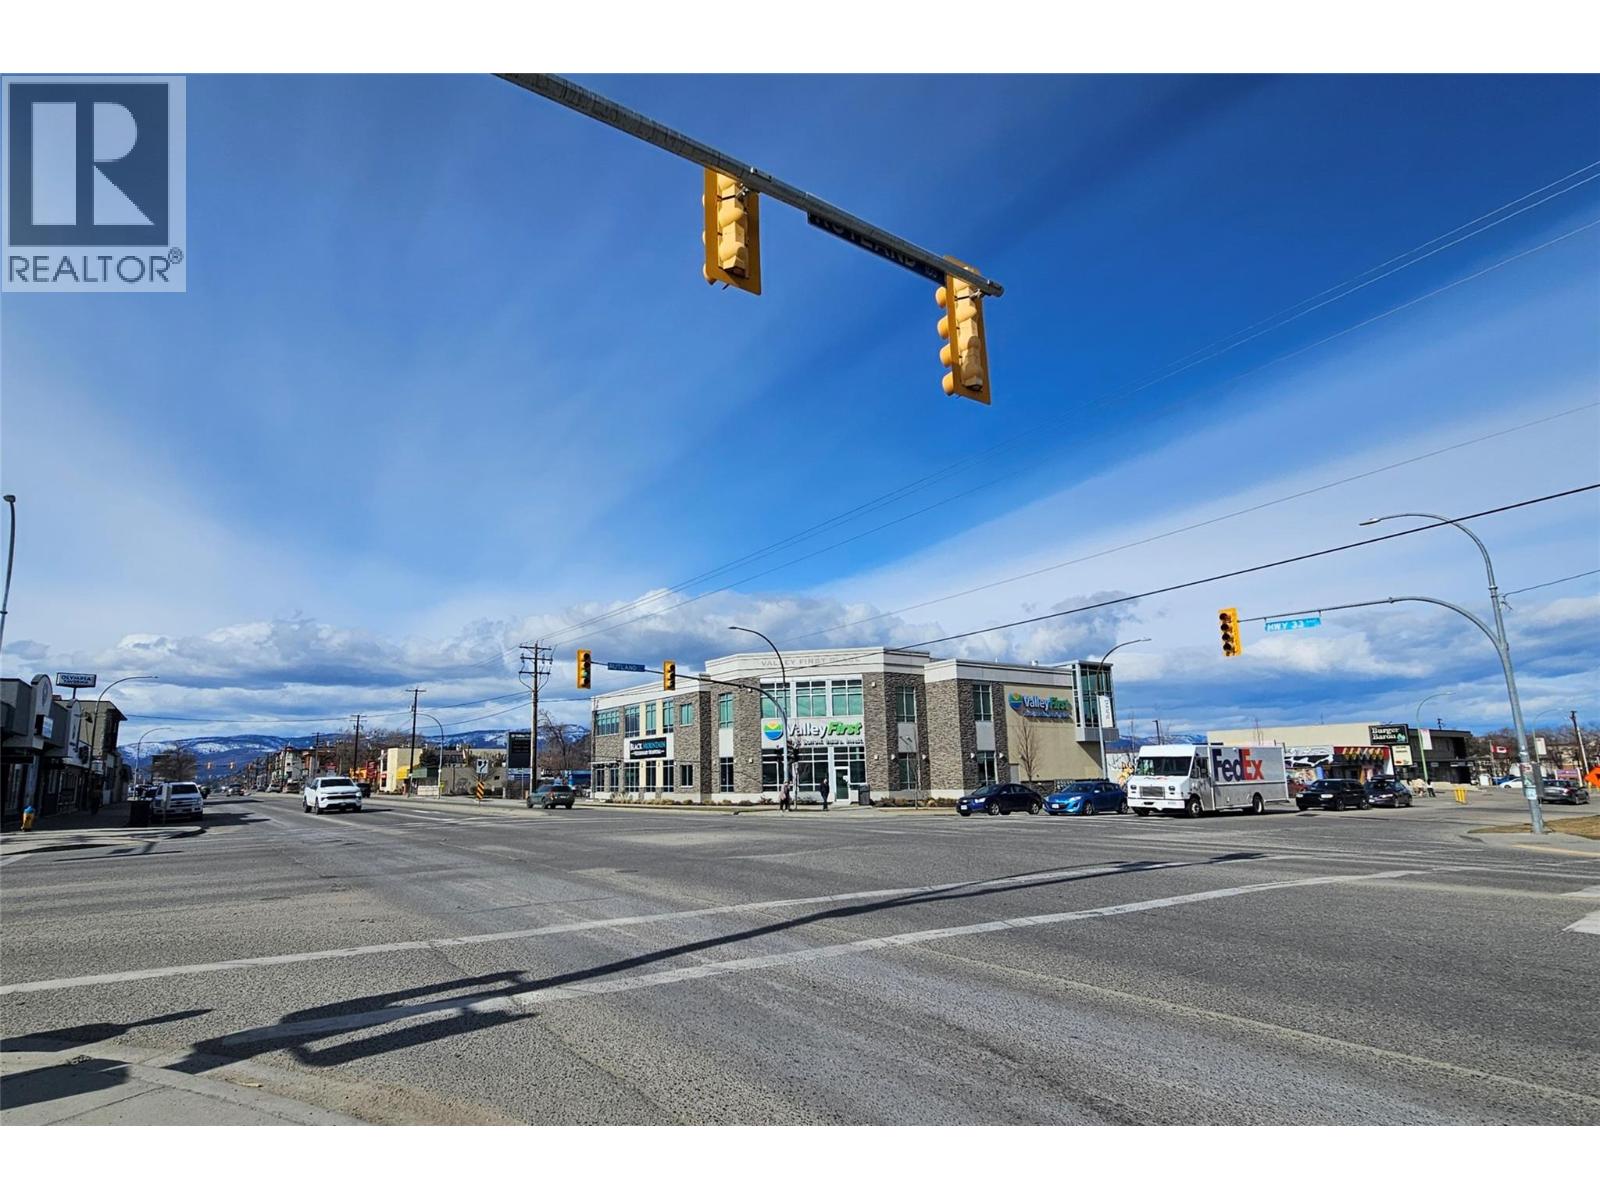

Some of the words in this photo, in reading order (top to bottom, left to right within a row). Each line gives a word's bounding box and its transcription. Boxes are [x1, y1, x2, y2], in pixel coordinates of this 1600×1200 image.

[1266, 621, 1288, 632] HWY
[1290, 619, 1305, 630] 33
[1371, 726, 1400, 735] Burger
[1211, 748, 1264, 782] FedEx
